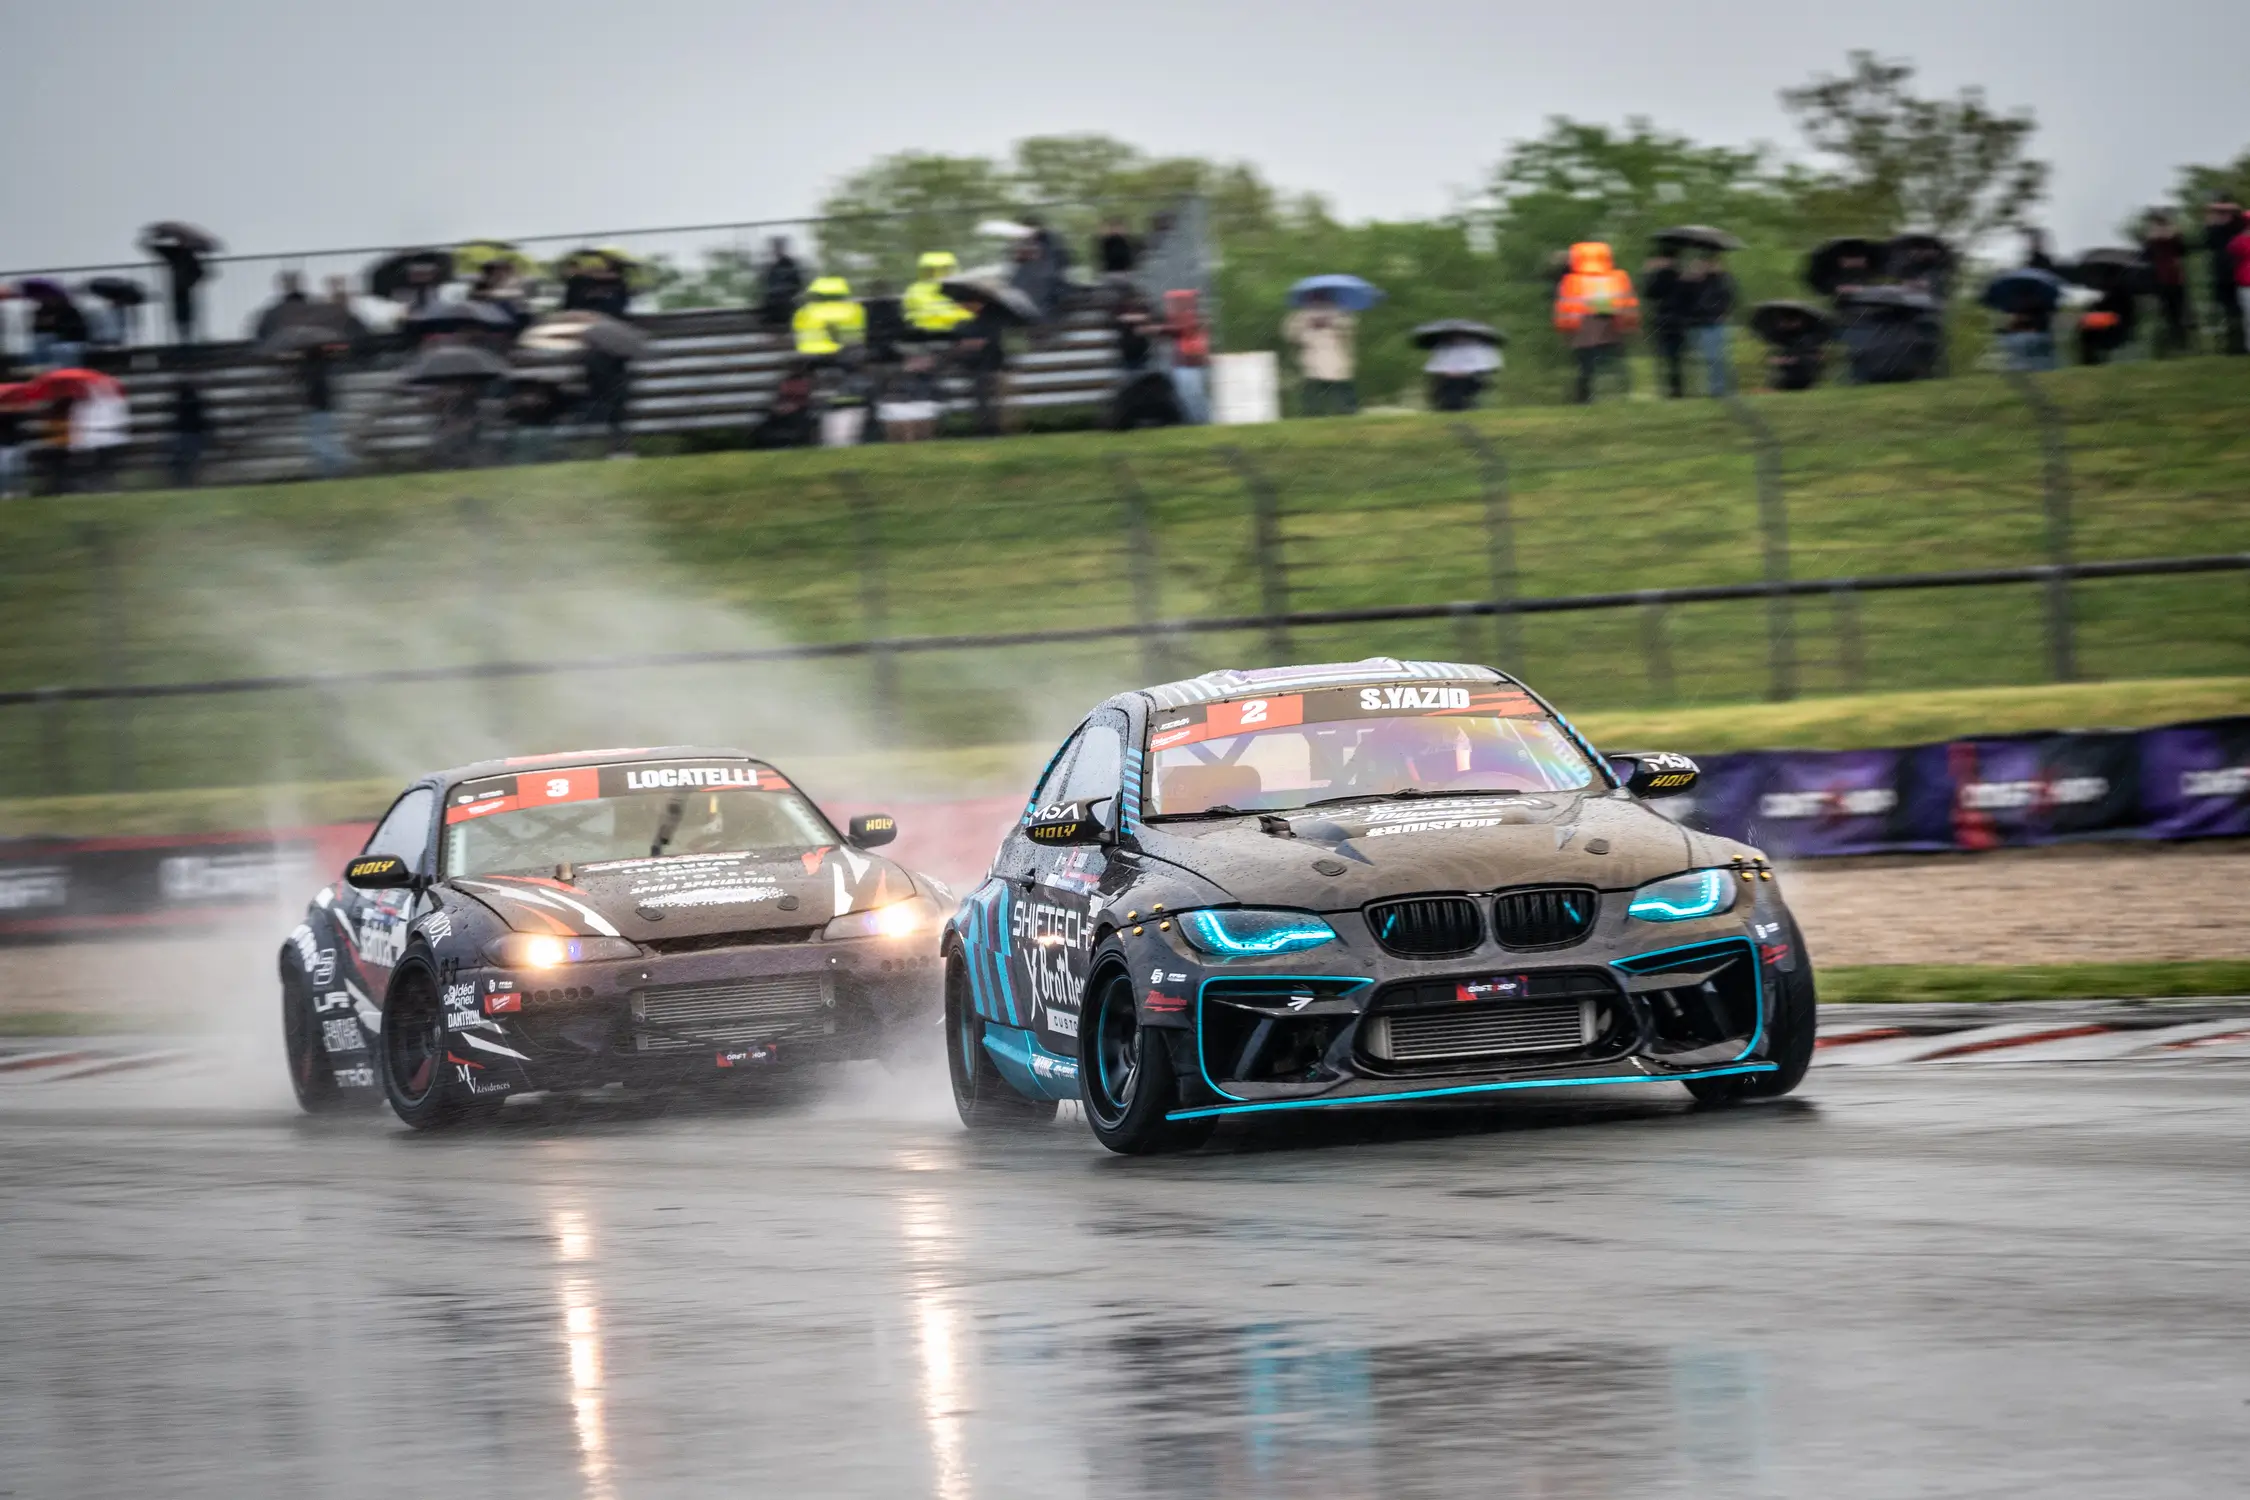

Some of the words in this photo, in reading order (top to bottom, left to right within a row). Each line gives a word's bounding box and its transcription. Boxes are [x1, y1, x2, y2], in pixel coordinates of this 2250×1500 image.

[1360, 687, 1470, 710] S.YAZID
[1240, 700, 1268, 725] 2
[546, 779, 569, 797] 3
[627, 768, 757, 789] LOCATELLI
[866, 818, 893, 831] HOLY
[1034, 823, 1077, 838] HOLY
[350, 861, 396, 877] HOLY
[1012, 900, 1094, 951] SHIFTECH
